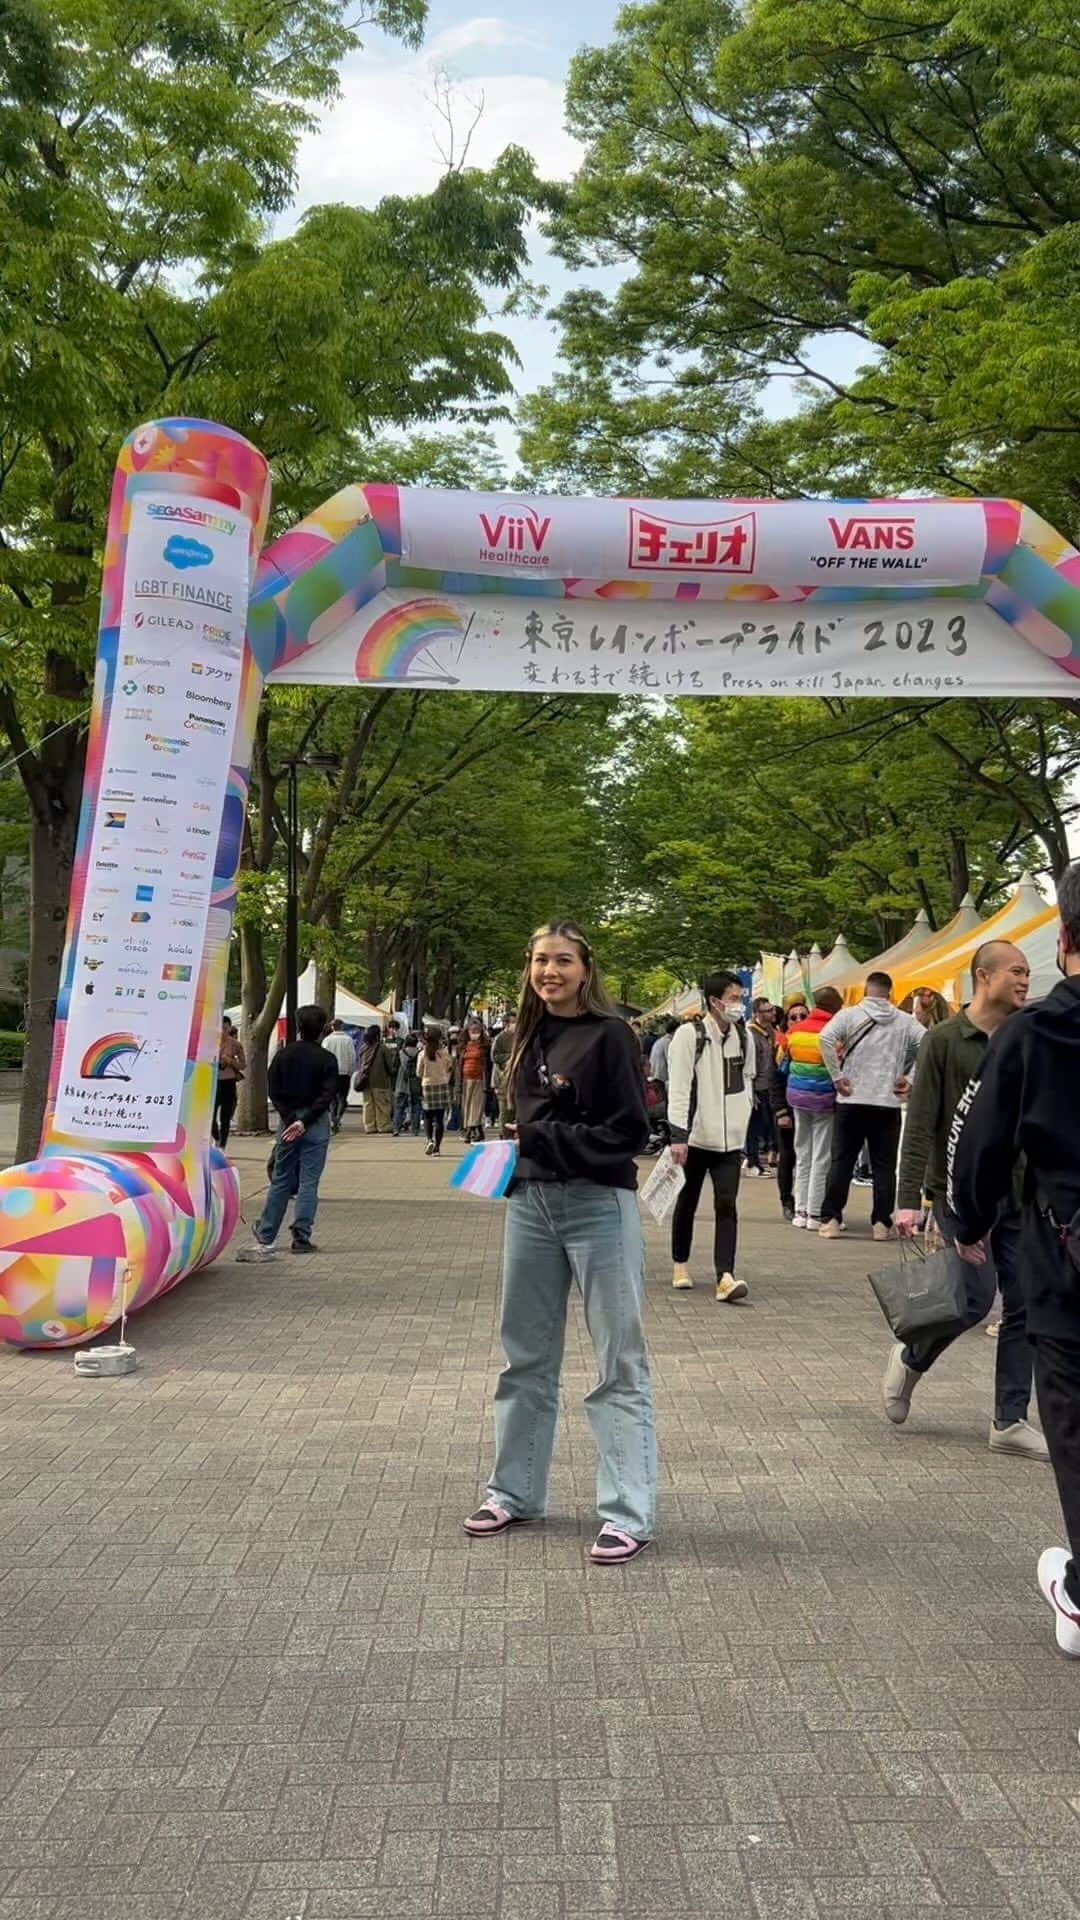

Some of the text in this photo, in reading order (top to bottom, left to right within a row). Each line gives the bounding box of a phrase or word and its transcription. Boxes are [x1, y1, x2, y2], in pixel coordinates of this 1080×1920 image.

[479, 511, 551, 552] ViiV
[638, 519, 747, 566] チェリオ
[828, 518, 915, 549] VANS
[479, 549, 549, 565] Healthcare
[849, 557, 878, 569] THE
[134, 580, 232, 610] LGBT FINANCE
[147, 615, 194, 630] GILEAD
[863, 615, 967, 656] 2023
[205, 666, 232, 681] アクサ
[722, 671, 763, 689] Press
[831, 671, 885, 695] Japan
[893, 672, 964, 690] changes
[185, 690, 232, 710] Bloomberg
[144, 1095, 174, 1106] 2023
[957, 1079, 982, 1115] THE
